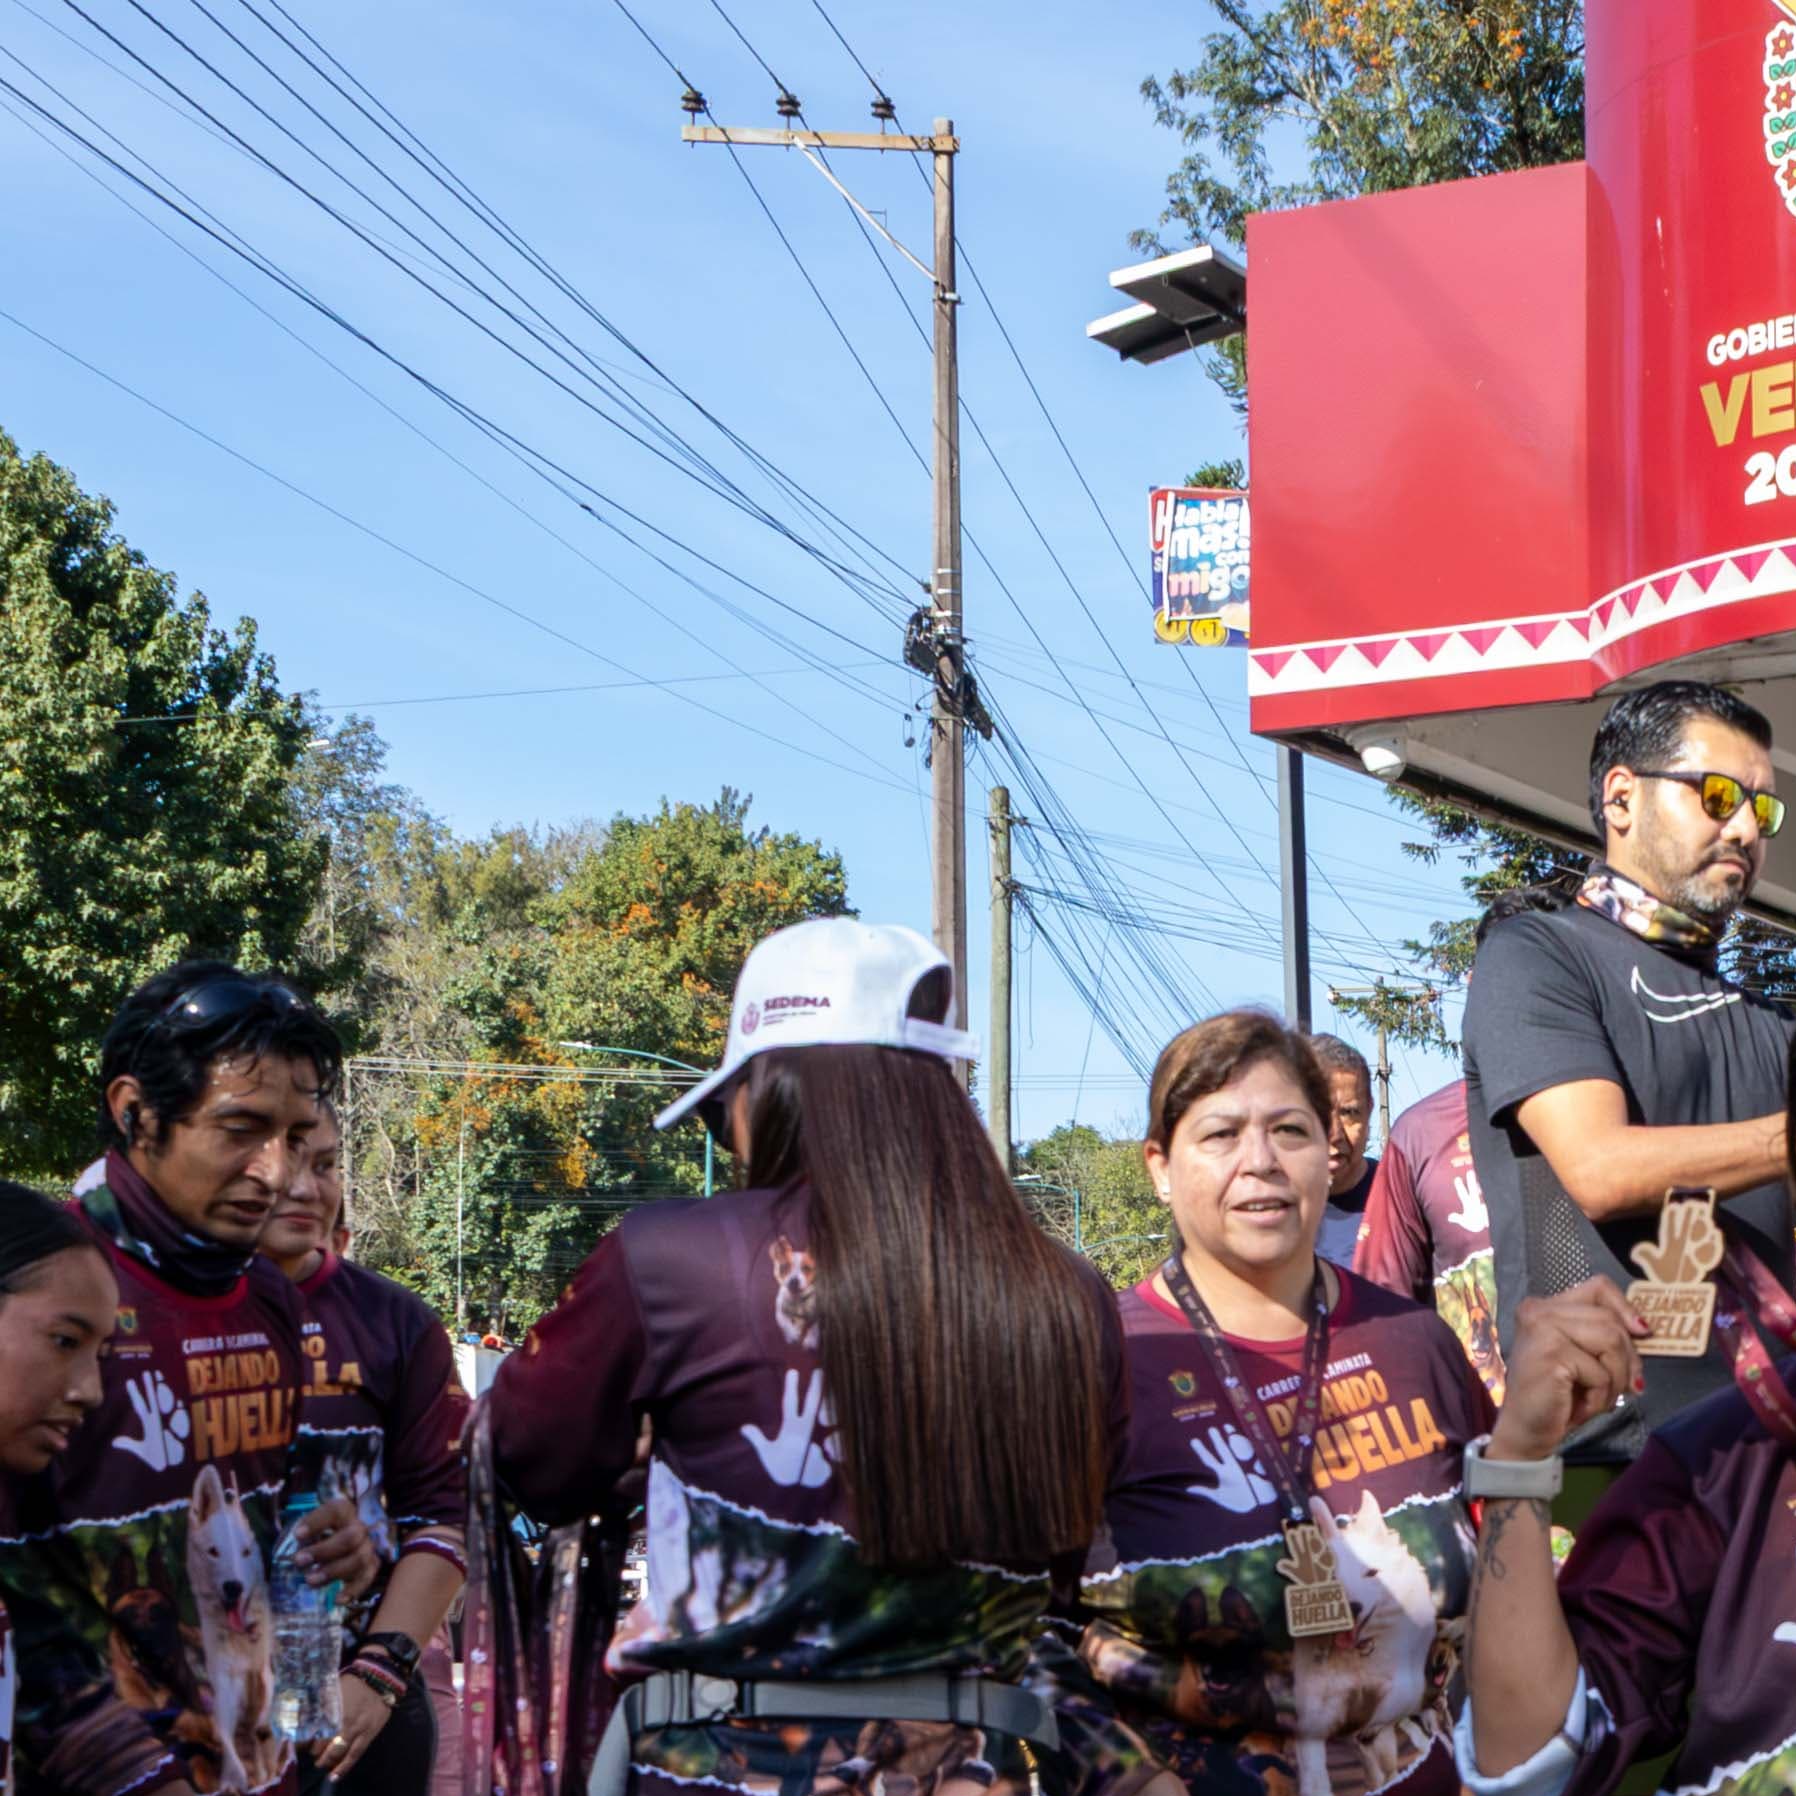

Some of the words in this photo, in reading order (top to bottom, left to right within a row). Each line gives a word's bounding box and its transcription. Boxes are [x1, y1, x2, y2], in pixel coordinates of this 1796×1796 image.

[186, 1350, 280, 1396] DEJANDO
[1323, 1352, 1373, 1380] AMINATA
[1291, 1601, 1349, 1628] HUELLA
